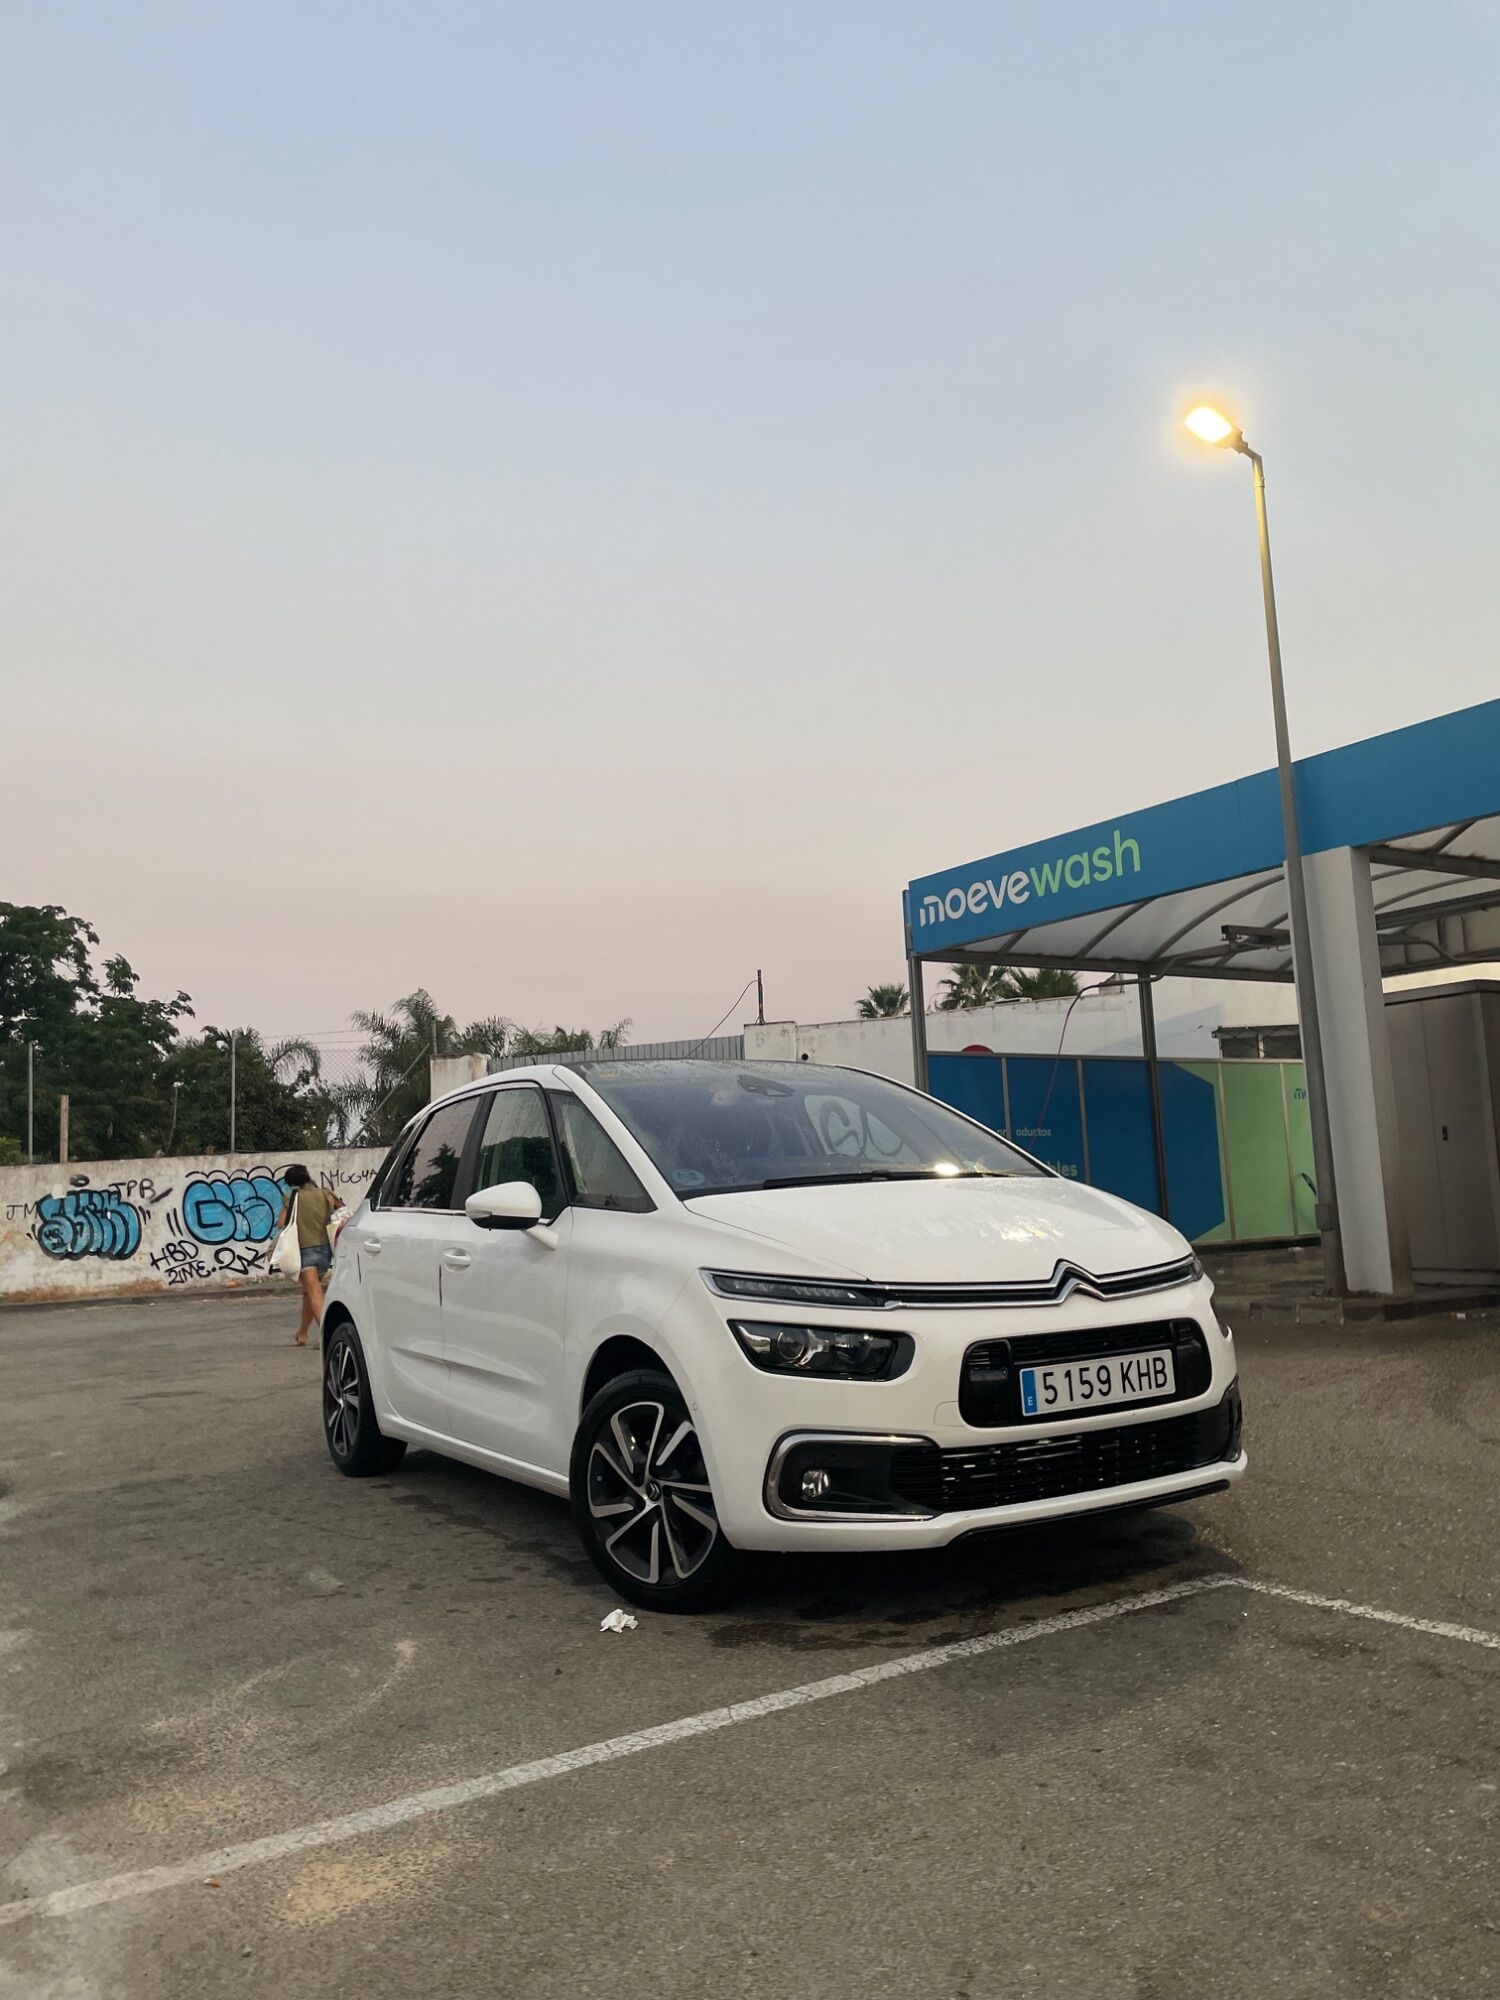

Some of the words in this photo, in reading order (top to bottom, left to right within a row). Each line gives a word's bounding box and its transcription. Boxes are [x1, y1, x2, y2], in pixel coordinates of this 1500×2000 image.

[919, 829, 1141, 928] moevewash
[1027, 1396, 1034, 1406] E
[1042, 1364, 1112, 1405] 5159
[1120, 1356, 1168, 1394] KHB
